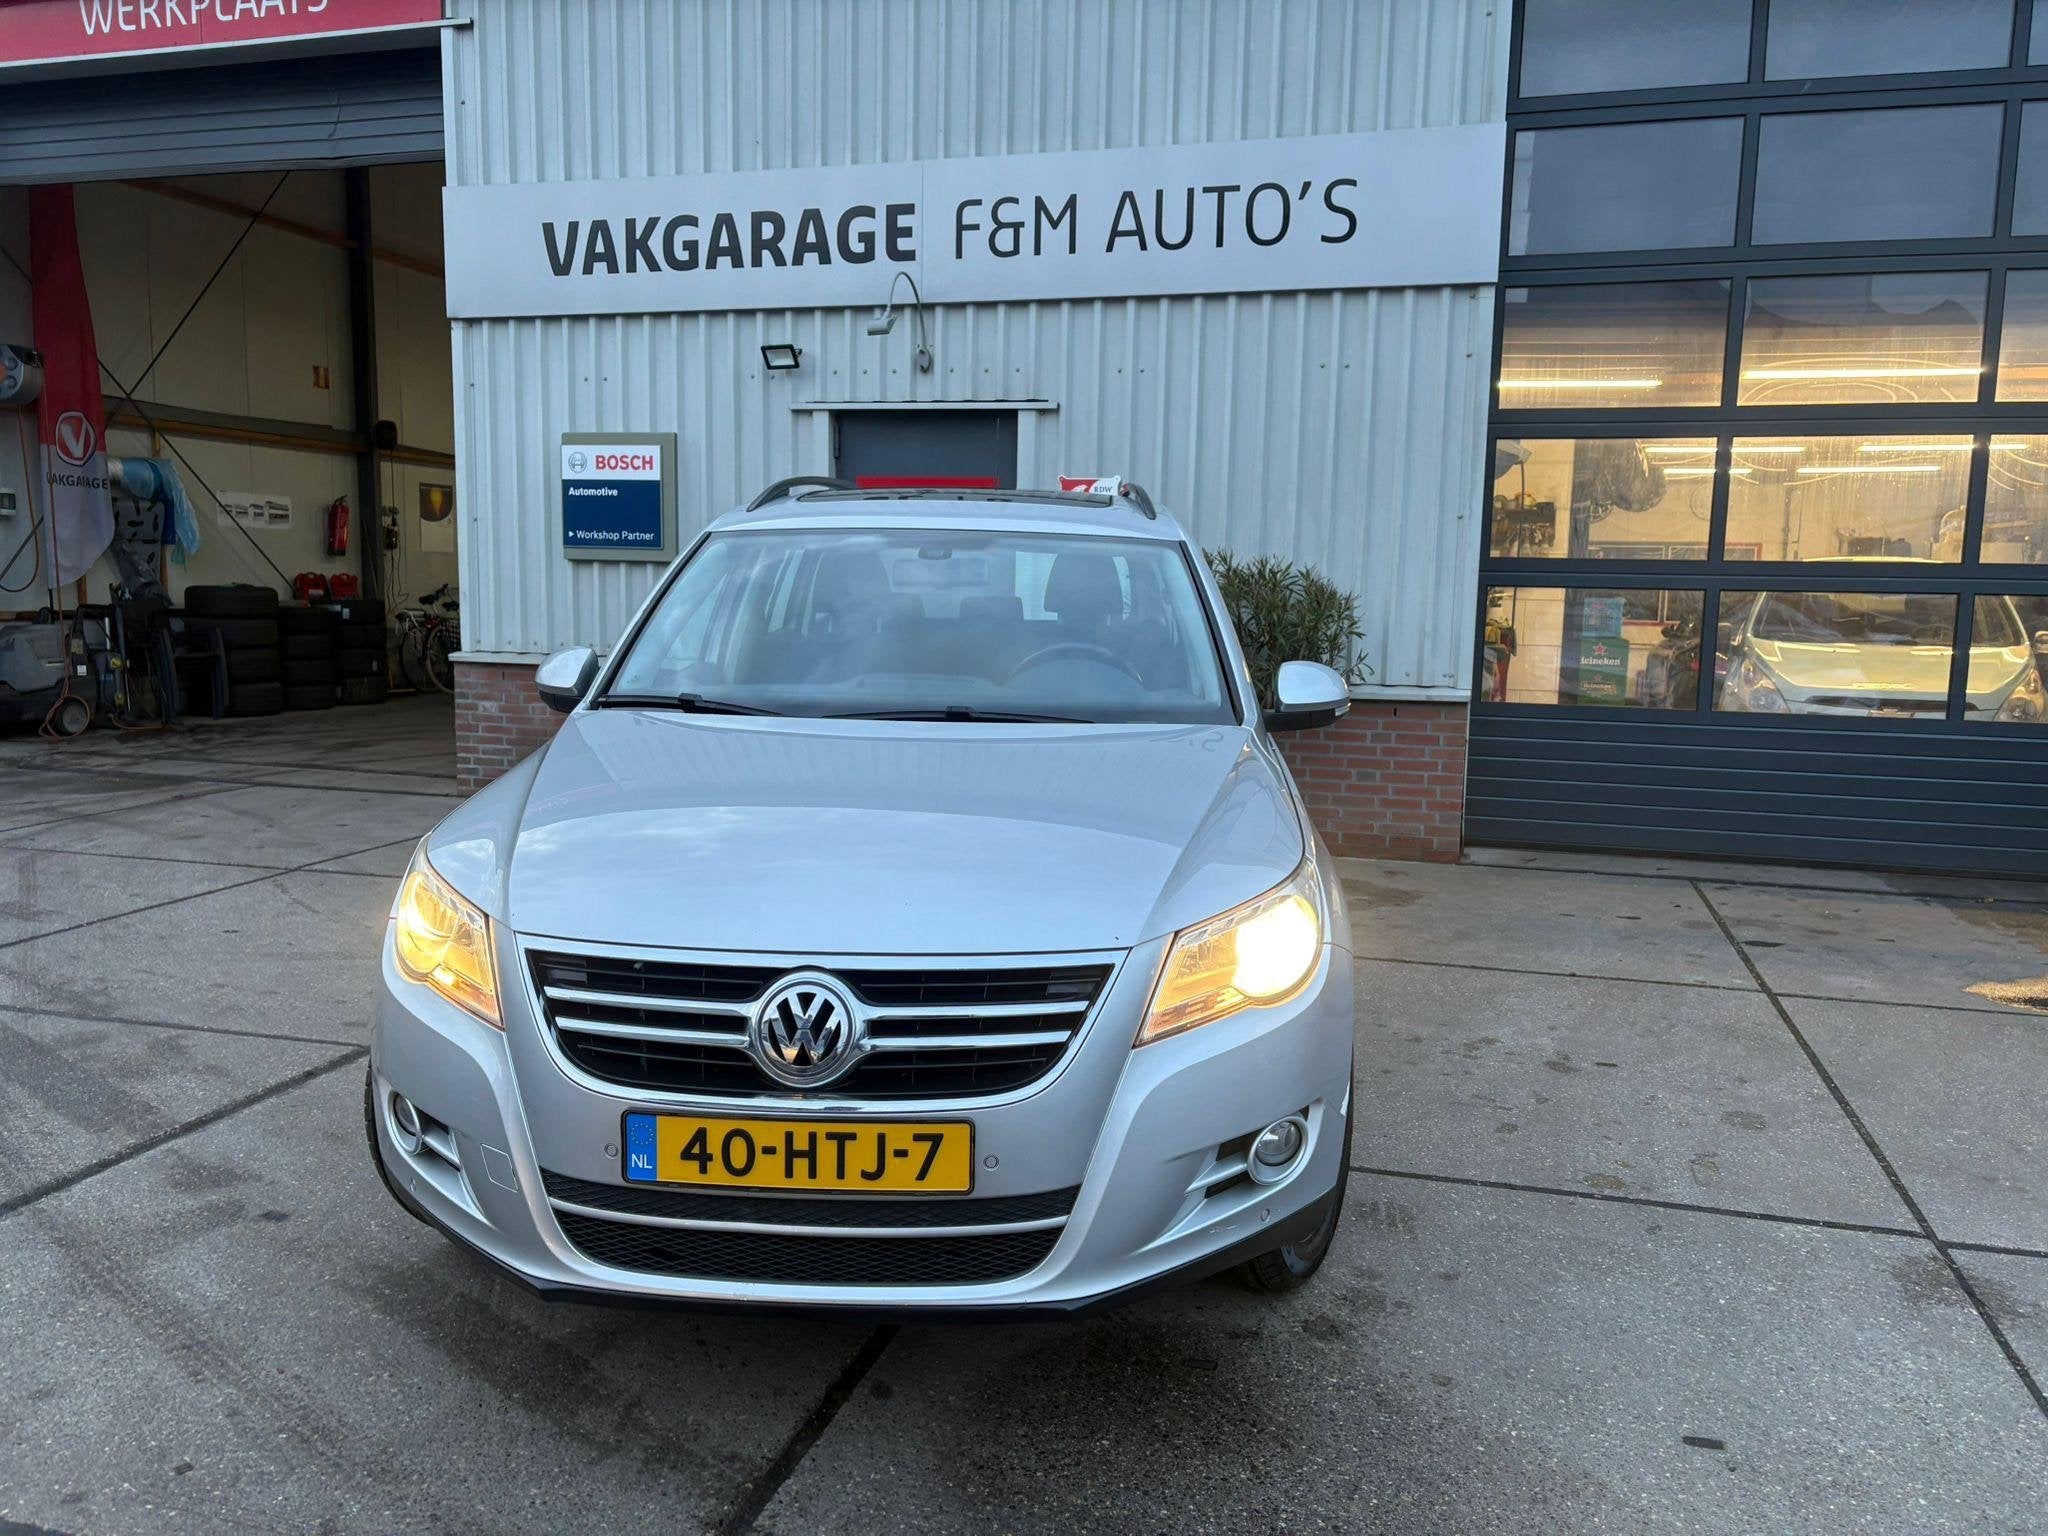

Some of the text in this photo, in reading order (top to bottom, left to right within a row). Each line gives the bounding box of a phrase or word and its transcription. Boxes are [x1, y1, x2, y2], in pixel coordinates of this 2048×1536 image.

[541, 178, 1358, 277] VAKGARAGE F&M AUTO'S
[595, 454, 654, 471] BOSCH
[568, 486, 618, 497] Automotive
[576, 529, 655, 541] Workshop Partner
[631, 1153, 653, 1169] NL
[680, 1126, 945, 1182] 40-HTJ-7
